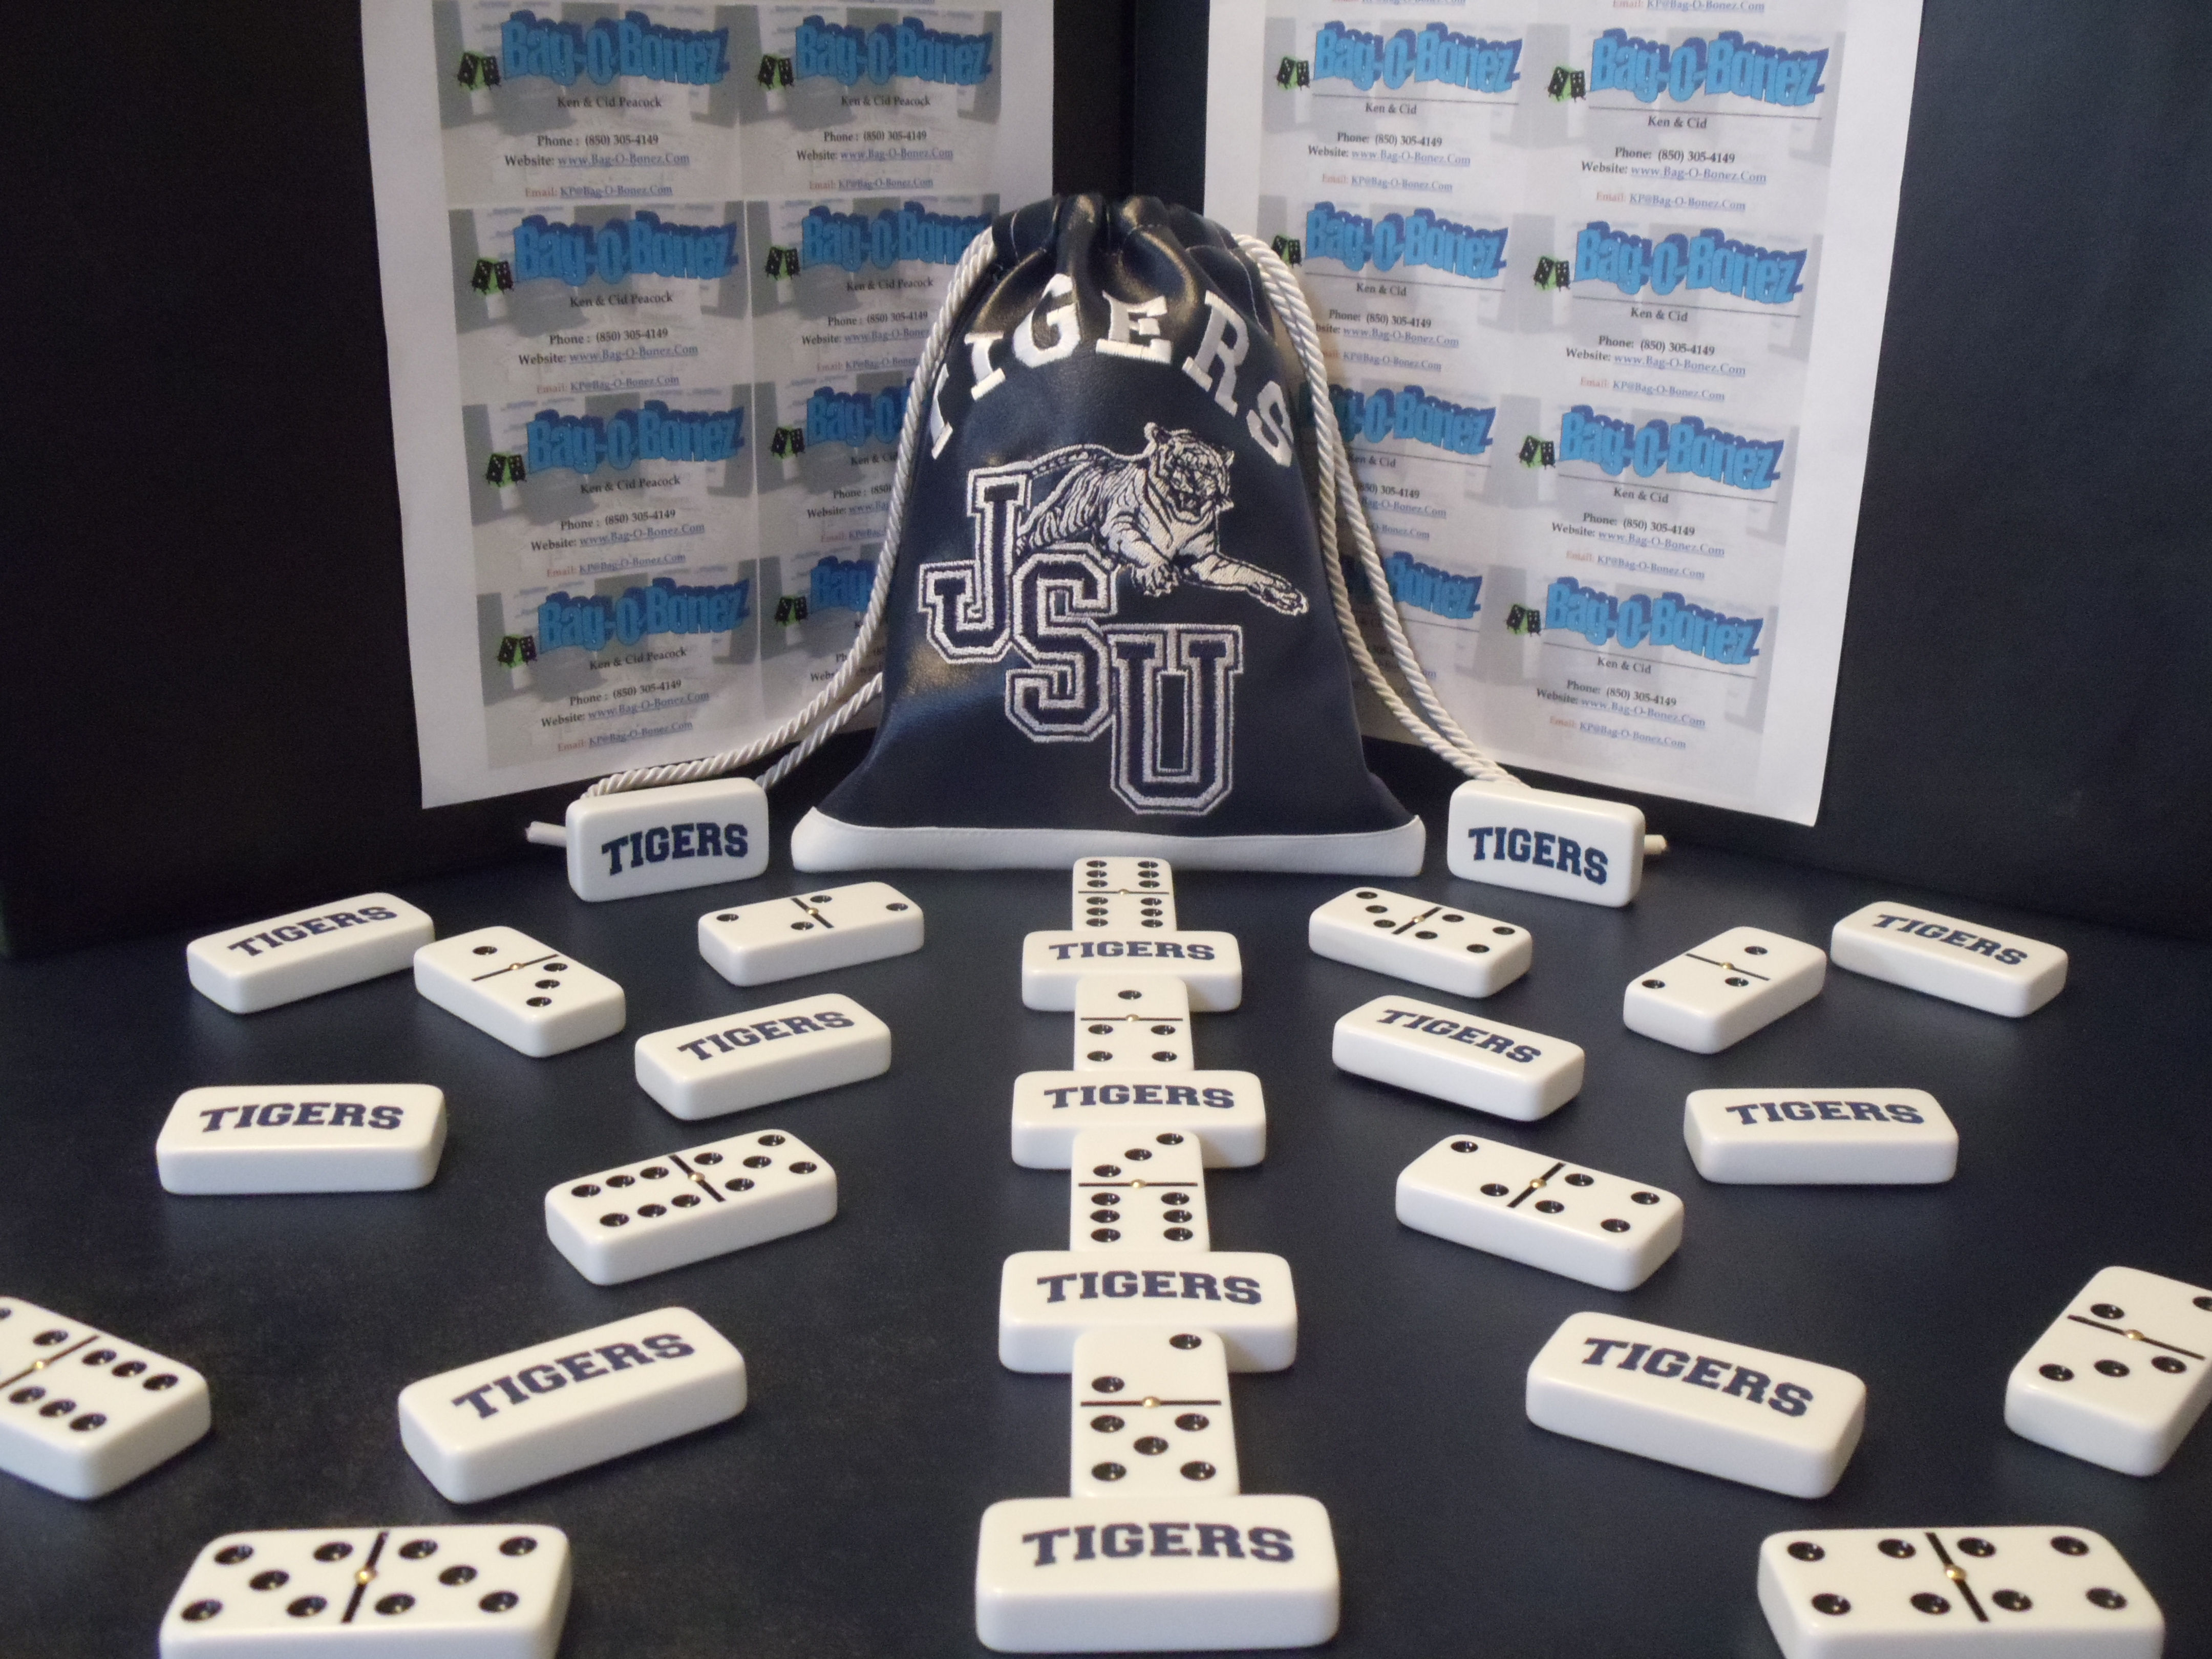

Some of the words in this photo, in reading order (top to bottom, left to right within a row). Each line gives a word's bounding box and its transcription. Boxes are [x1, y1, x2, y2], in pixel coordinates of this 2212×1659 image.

[557, 97, 581, 108] Ken
[583, 97, 592, 108] &
[596, 97, 614, 108] Cid
[619, 97, 662, 108] Peacock
[841, 95, 861, 106] Ken
[863, 95, 870, 105] &
[874, 95, 892, 105] Cid
[894, 95, 930, 106] Peacock
[1365, 103, 1385, 113] Ken
[1389, 105, 1396, 114] &
[1399, 104, 1417, 115] Cid
[1648, 116, 1670, 127] Ken
[1674, 117, 1683, 127] &
[1687, 117, 1707, 129] Cid
[585, 134, 610, 146] (850)
[614, 135, 658, 145] 305-4149
[863, 131, 884, 142] (850)
[888, 131, 926, 141] 305-4149
[1337, 132, 1369, 143] Phone:
[1375, 135, 1397, 146] (850)
[1400, 136, 1442, 146] 305-4149
[505, 155, 554, 166] Website:
[558, 155, 690, 167] www.Bag-O-Bonez.Com
[797, 150, 837, 161] Website:
[841, 148, 953, 161] www.Bag-O-Bonez.Com
[1308, 145, 1348, 157] Website:
[1352, 150, 1471, 166] www.Bag-O-Bonez.Com
[1615, 147, 1652, 158] Phone:
[1658, 150, 1684, 162] (850)
[1688, 151, 1735, 163] 305-4149
[1582, 161, 1627, 175] Website:
[1631, 166, 1766, 185] www.Bag-O-Bonez.Com
[847, 281, 864, 291] Ken
[878, 280, 894, 289] Cid
[899, 277, 933, 288] Peacock
[1356, 283, 1376, 293] Ken
[1379, 285, 1387, 294] &
[1390, 286, 1406, 296] Cid
[570, 295, 592, 307] Ken
[596, 296, 605, 305] &
[609, 294, 627, 305] Cid
[631, 291, 672, 305] Peacock
[867, 314, 887, 324] (850)
[891, 311, 927, 321] 305-4149
[1329, 309, 1360, 321] Phone:
[1367, 314, 1388, 325] (850)
[1392, 316, 1431, 328] 305-4149
[1631, 307, 1652, 320] Ken
[1656, 309, 1664, 320] &
[1668, 311, 1688, 322] Cid
[597, 331, 620, 342] (850)
[624, 328, 668, 340] 305-4149
[802, 334, 841, 346] Website:
[1344, 327, 1459, 347] www.Bag-O-Bonez.Com
[1599, 335, 1634, 348] Phone:
[1640, 340, 1666, 353] (850)
[1669, 343, 1714, 355] 305-4149
[519, 353, 566, 365] Website:
[570, 345, 698, 364] www.Bag-O-Bonez.Com
[1566, 348, 1610, 361] Website:
[1614, 353, 1746, 377] www.Bag-O-Bonez.Com
[581, 482, 601, 494] Ken
[605, 482, 613, 491] &
[618, 480, 635, 490] Cid
[639, 475, 680, 488] Peacock
[1614, 488, 1634, 499] Ken
[1638, 491, 1646, 500] &
[1650, 492, 1669, 503] Cid
[605, 515, 628, 526] (850)
[632, 509, 675, 522] 305-4149
[1583, 513, 1617, 525] Phone:
[1623, 518, 1647, 531] (850)
[1650, 522, 1695, 536] 305-4149
[531, 539, 577, 551] Website:
[580, 523, 705, 546] www.Bag-O-Bonez.Com
[1552, 522, 1594, 537] Website:
[1599, 530, 1725, 556] www.Bag-O-Bonez.Com
[919, 463, 1243, 815] JSU
[590, 660, 611, 671] Ken
[614, 657, 621, 666] &
[626, 654, 645, 665] Cid
[647, 649, 687, 662] Peacock
[1598, 657, 1618, 669] Ken
[1621, 661, 1629, 671] &
[1633, 662, 1651, 674] Cid
[613, 688, 636, 699] (850)
[641, 680, 681, 694] 305-4149
[1567, 679, 1600, 694] Phone:
[1606, 688, 1629, 700] (850)
[1633, 692, 1676, 706] 305-4149
[542, 714, 585, 728] Website:
[588, 692, 709, 721] www.Bag-O-Bonez.Com
[1537, 689, 1578, 703] Website:
[1581, 697, 1706, 727] www.Bag-O-Bonez.Com
[602, 822, 748, 876] TIGERS
[1468, 827, 1608, 885] TIGERS
[228, 906, 397, 957] TIGERS
[1873, 914, 2028, 966] TIGERS
[1049, 941, 1215, 961] TIGERS
[677, 1011, 855, 1060] TIGERS
[1377, 1009, 1541, 1063] TIGERS
[1044, 1084, 1235, 1109] TIGERS
[200, 1102, 404, 1133] TIGERS
[1726, 1100, 1924, 1125] TIGERS
[1037, 1270, 1262, 1305] TIGERS
[451, 1333, 695, 1419] TIGERS
[1581, 1337, 1814, 1417] TIGERS
[1023, 1522, 1294, 1566] TIGERS
